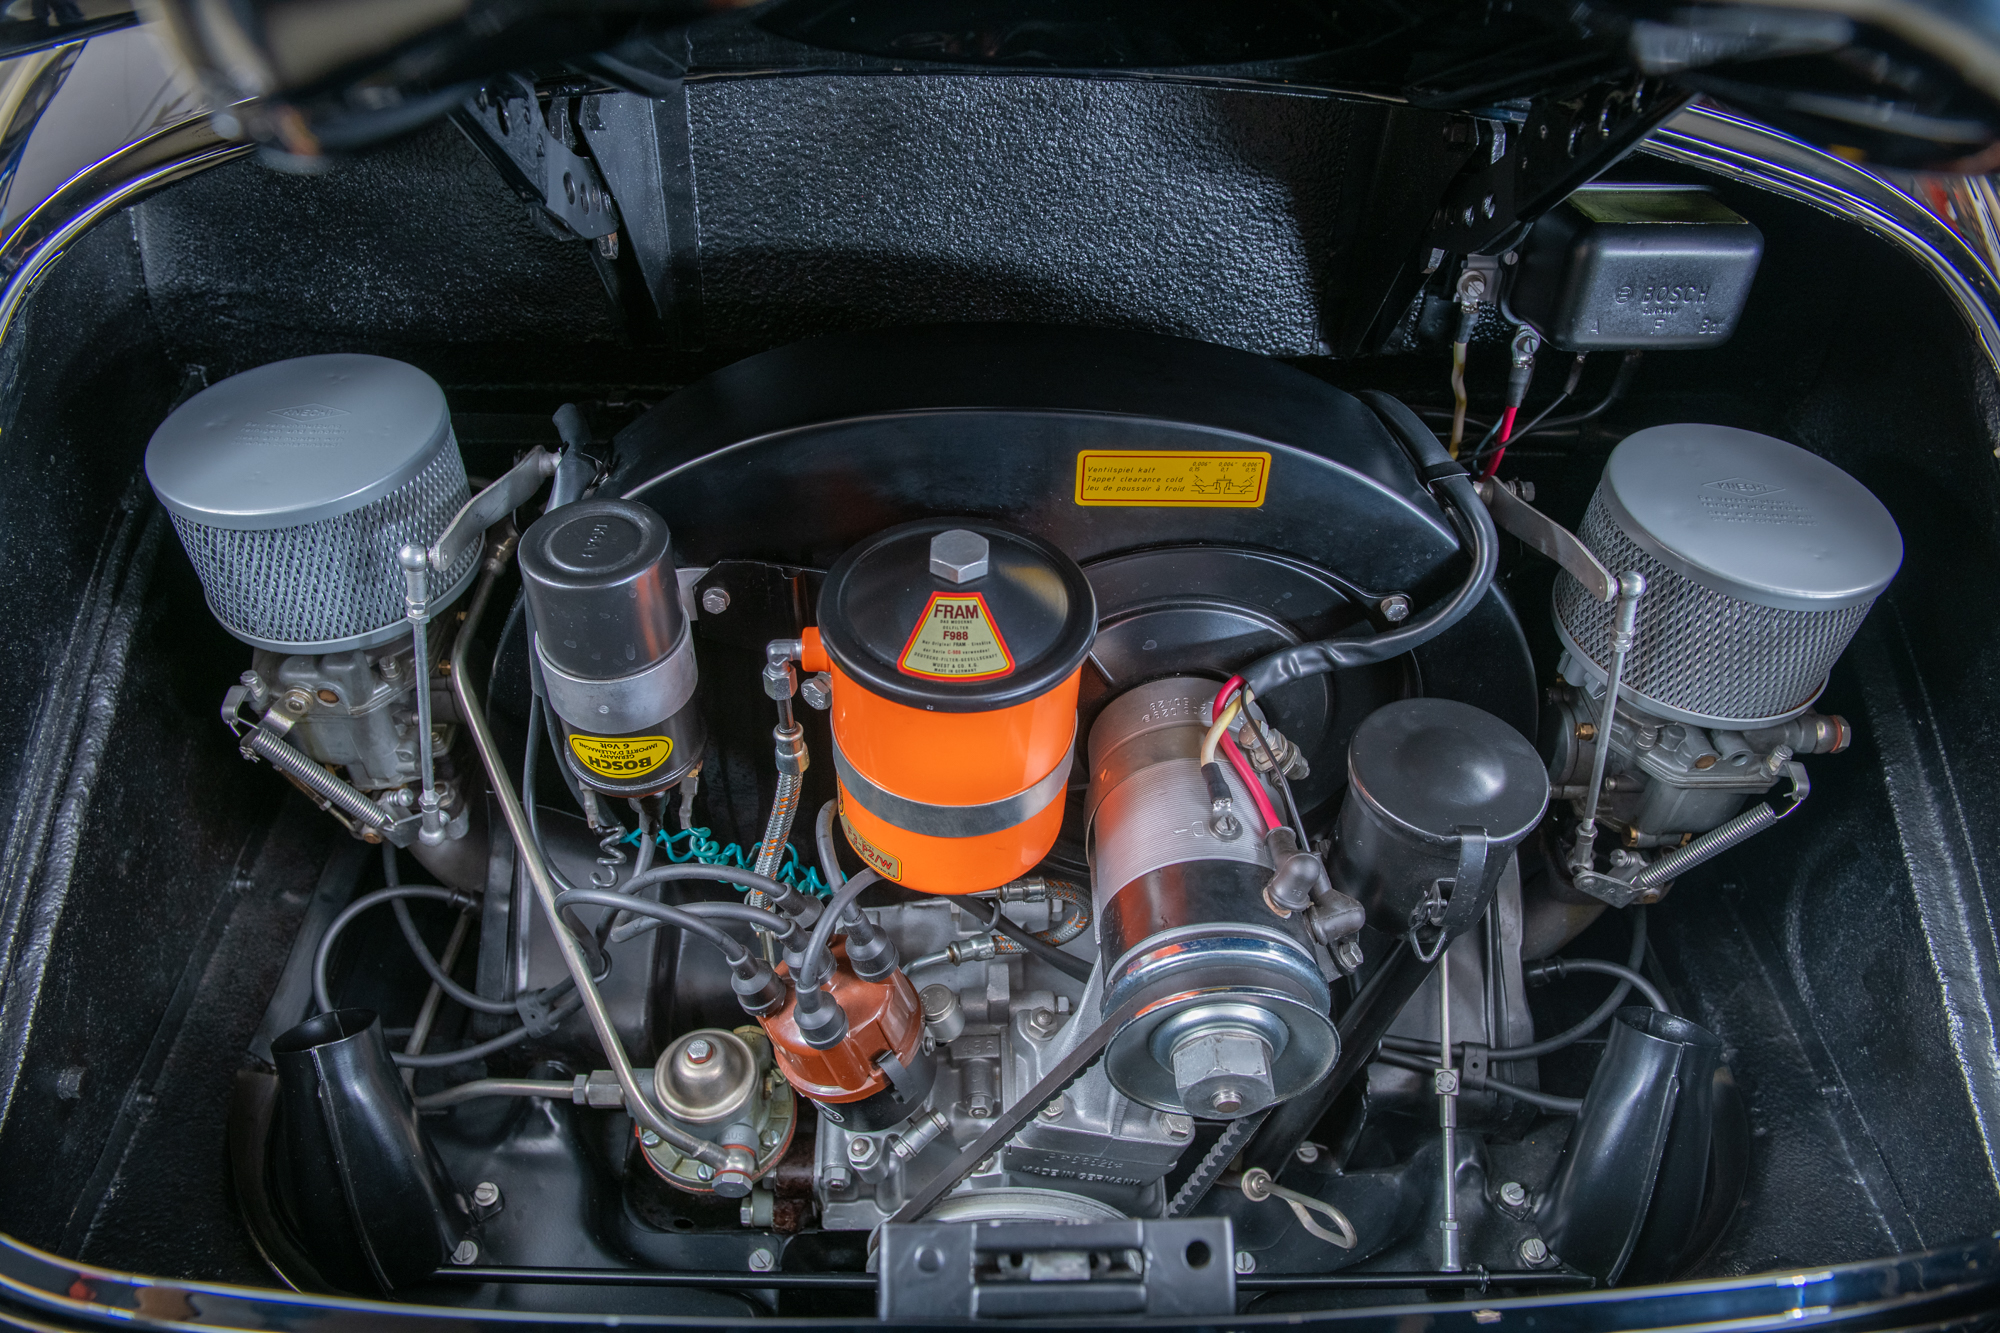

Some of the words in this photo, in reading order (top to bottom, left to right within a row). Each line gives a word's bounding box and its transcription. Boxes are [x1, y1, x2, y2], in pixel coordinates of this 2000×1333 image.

[1641, 285, 1711, 304] BOSCH
[1650, 319, 1666, 335] F
[1087, 466, 1134, 475] Ventilspiel
[1087, 475, 1116, 484] Tappet
[1116, 485, 1152, 493] poussoir
[934, 603, 979, 619] FRAM
[942, 630, 969, 641] F988
[600, 742, 620, 750] Volt
[627, 742, 658, 755] IMPORTE
[587, 755, 652, 771] BOSCH
[1019, 1165, 1060, 1177] MADE
[1060, 1170, 1076, 1178] IN
[1077, 1172, 1142, 1186] GERMANY
